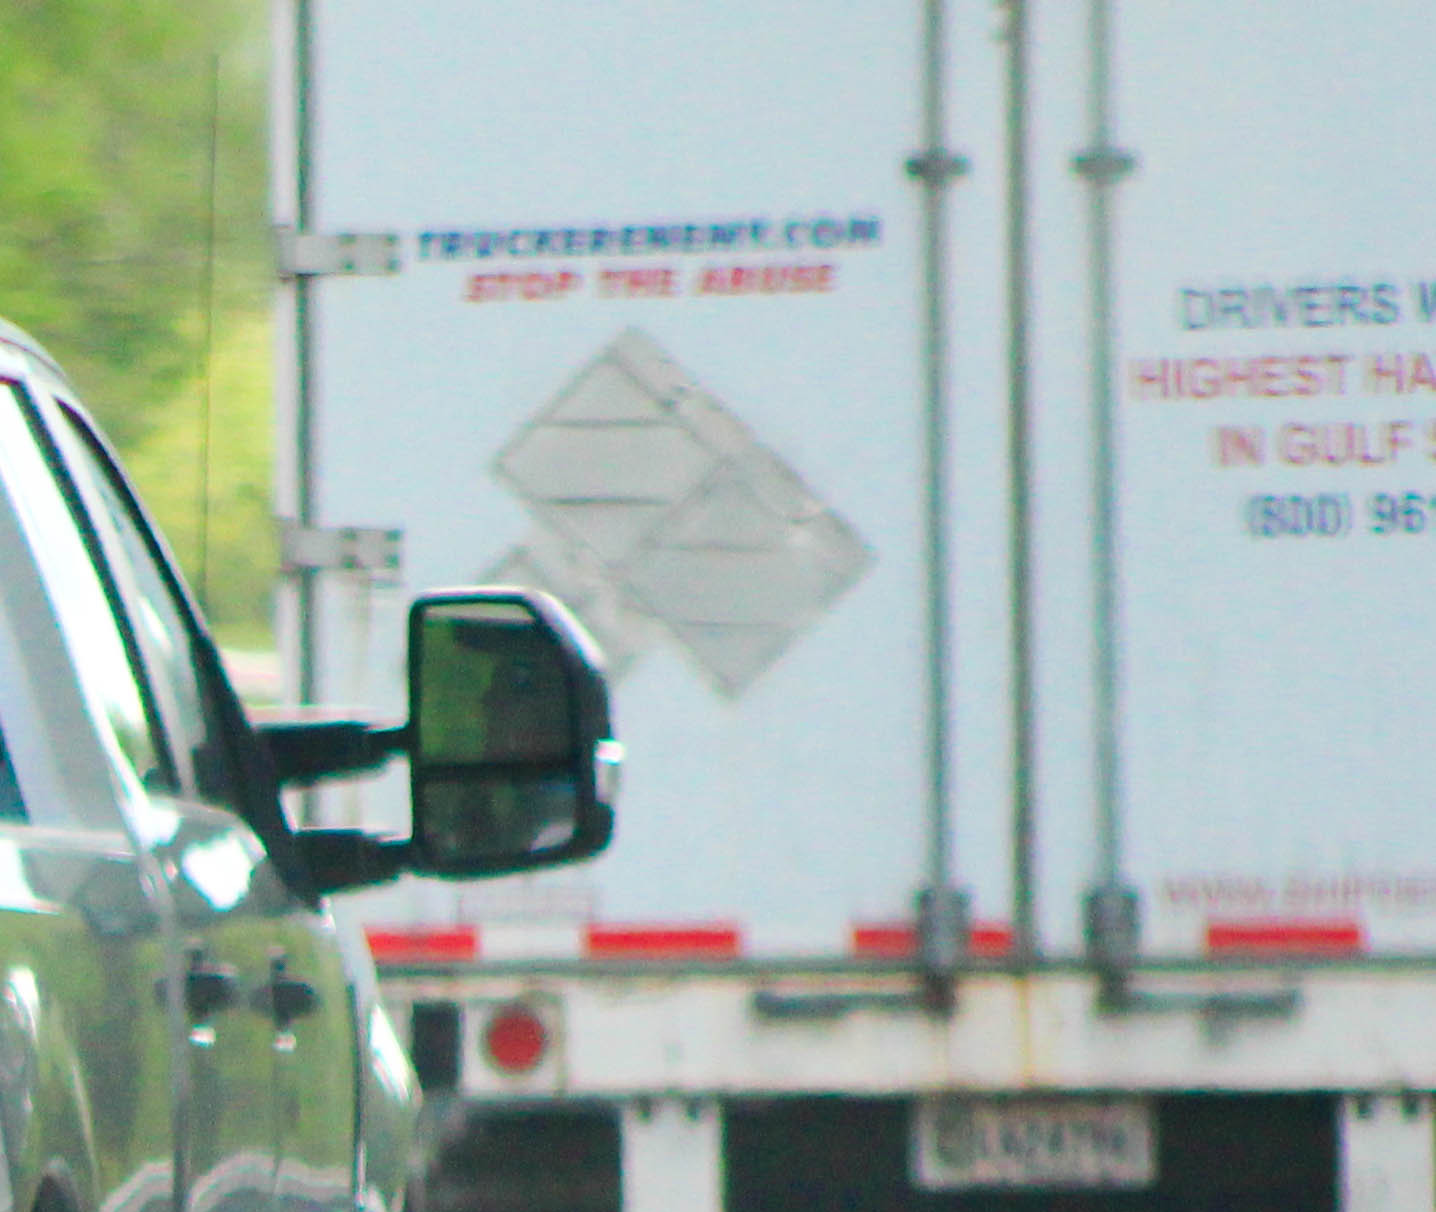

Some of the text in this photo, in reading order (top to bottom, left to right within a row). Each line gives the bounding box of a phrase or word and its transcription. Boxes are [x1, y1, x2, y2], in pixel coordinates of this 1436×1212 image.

[463, 270, 576, 303] STOP
[1178, 281, 1400, 331] DRIVERS
[1129, 352, 1356, 401] HIGHEST
[1216, 422, 1268, 468] IN
[1279, 417, 1418, 466] GULF
